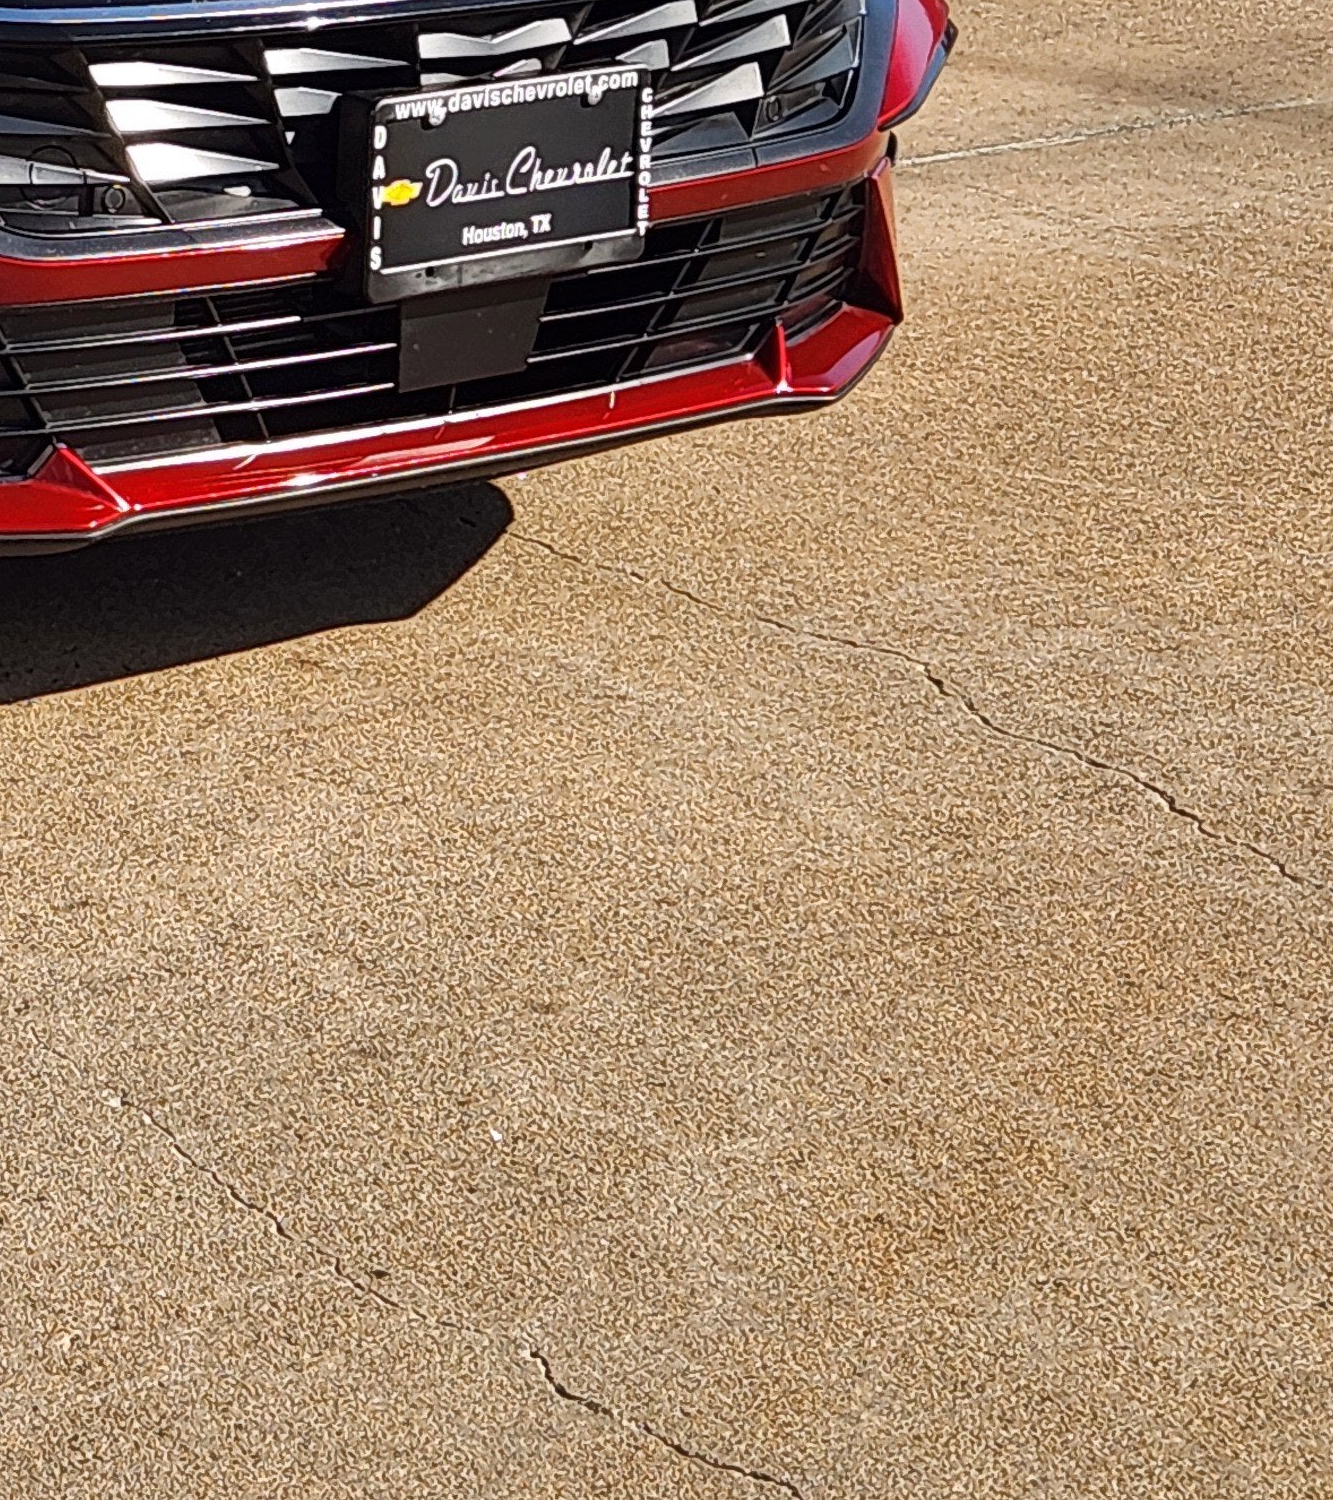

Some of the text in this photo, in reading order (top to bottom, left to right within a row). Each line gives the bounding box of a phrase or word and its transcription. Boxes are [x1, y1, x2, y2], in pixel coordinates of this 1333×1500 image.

[394, 71, 639, 121] www.davischevrolet.com
[425, 145, 635, 208] Davis Chevrolet
[637, 87, 654, 237] CHEVROLET
[370, 125, 388, 271] DAVIS
[462, 213, 552, 246] Houston, TX
